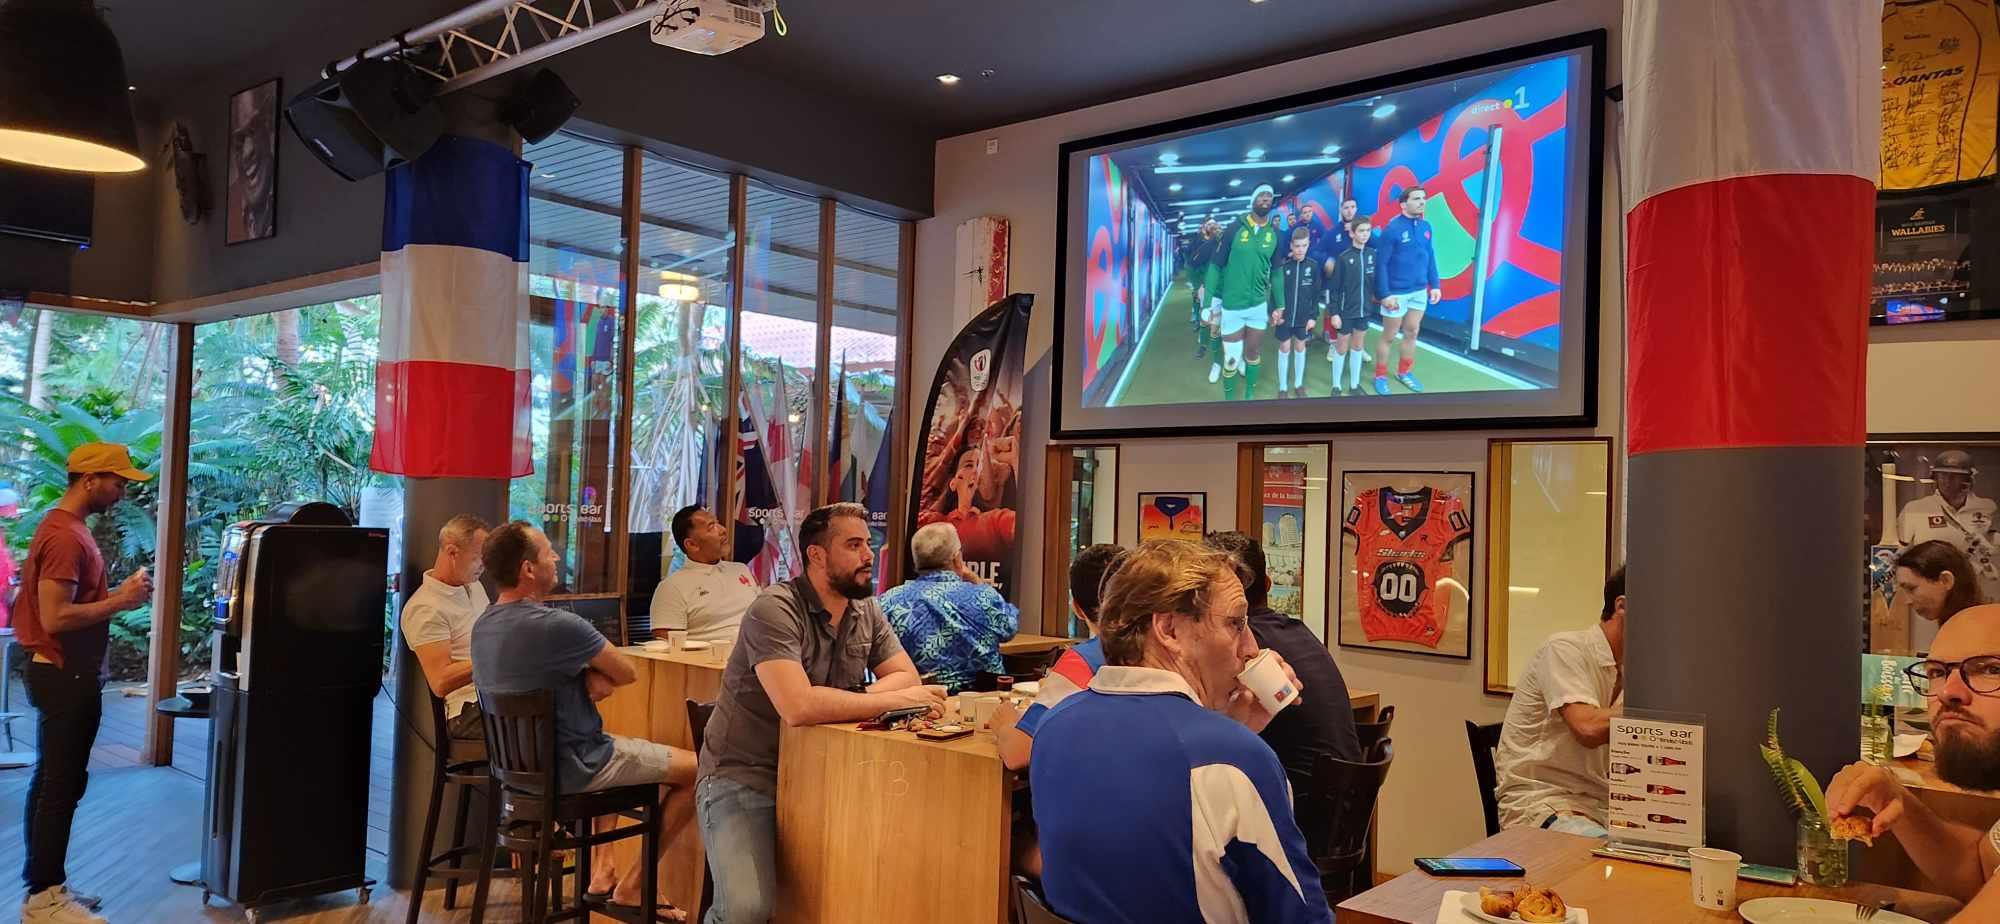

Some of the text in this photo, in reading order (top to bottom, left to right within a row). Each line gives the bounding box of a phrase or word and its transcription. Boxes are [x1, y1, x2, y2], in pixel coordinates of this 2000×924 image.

[1893, 65, 1966, 86] QANTAS
[1471, 86, 1530, 114] direct 1
[1891, 224, 1945, 237] WALLABIES
[748, 507, 784, 519] sports
[1380, 572, 1417, 603] 00
[1616, 725, 1664, 736] sports
